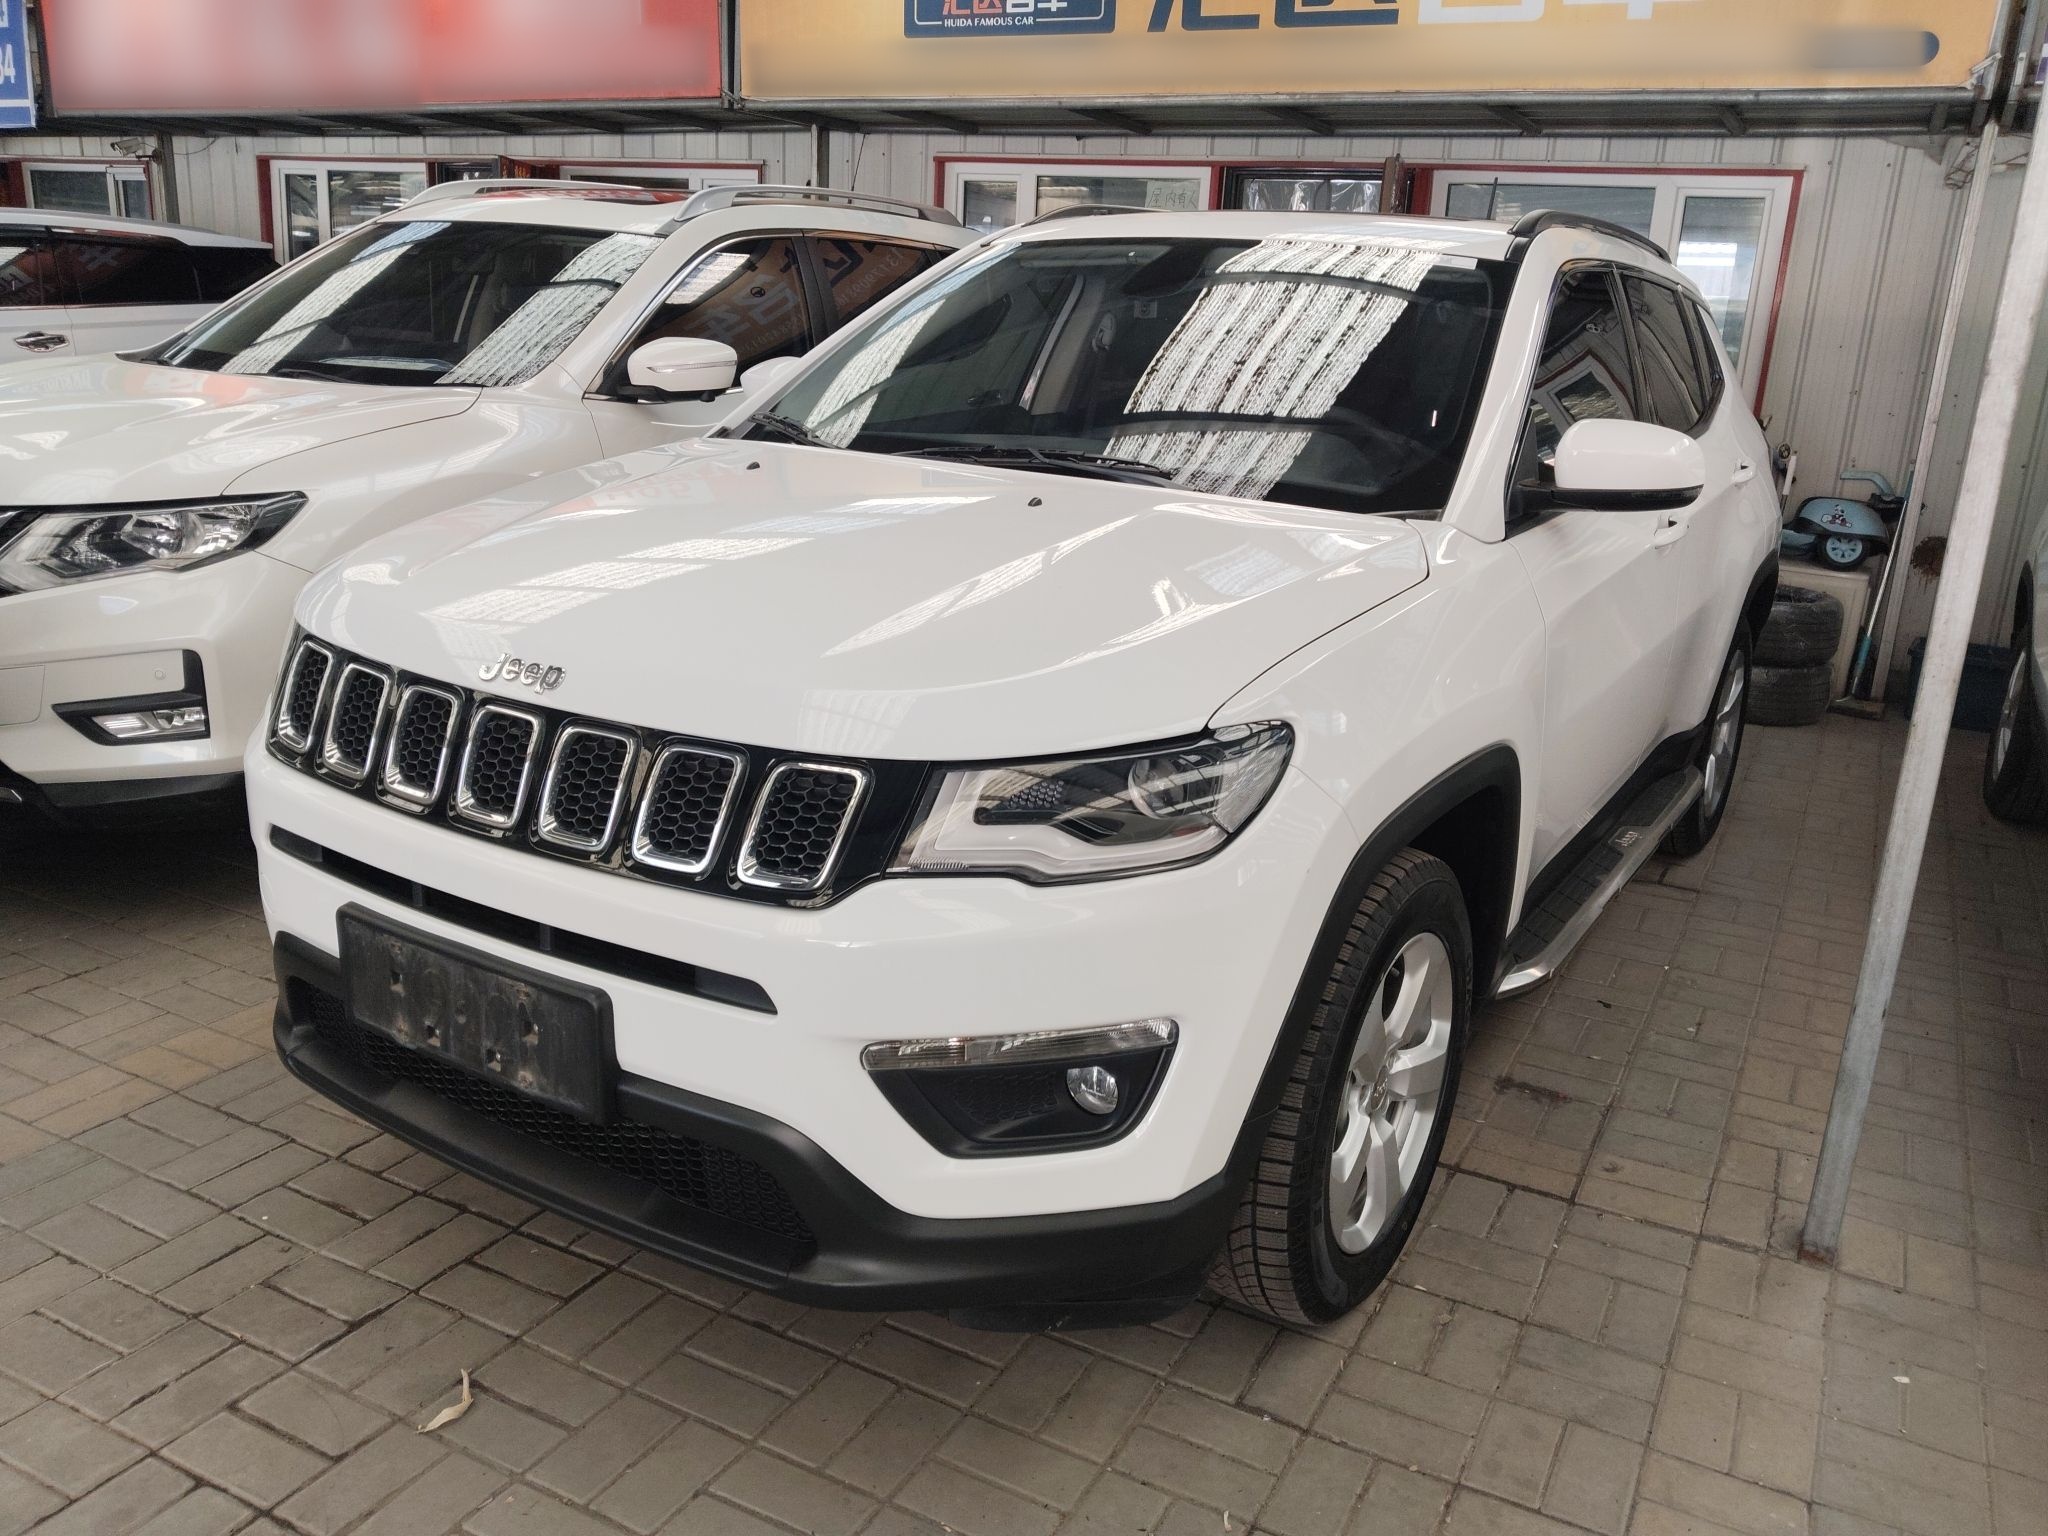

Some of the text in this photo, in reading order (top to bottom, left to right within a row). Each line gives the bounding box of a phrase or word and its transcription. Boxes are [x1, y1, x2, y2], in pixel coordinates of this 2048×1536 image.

[944, 16, 1035, 28] HUIDA FAMOUS CAR
[478, 652, 566, 695] Jeep
